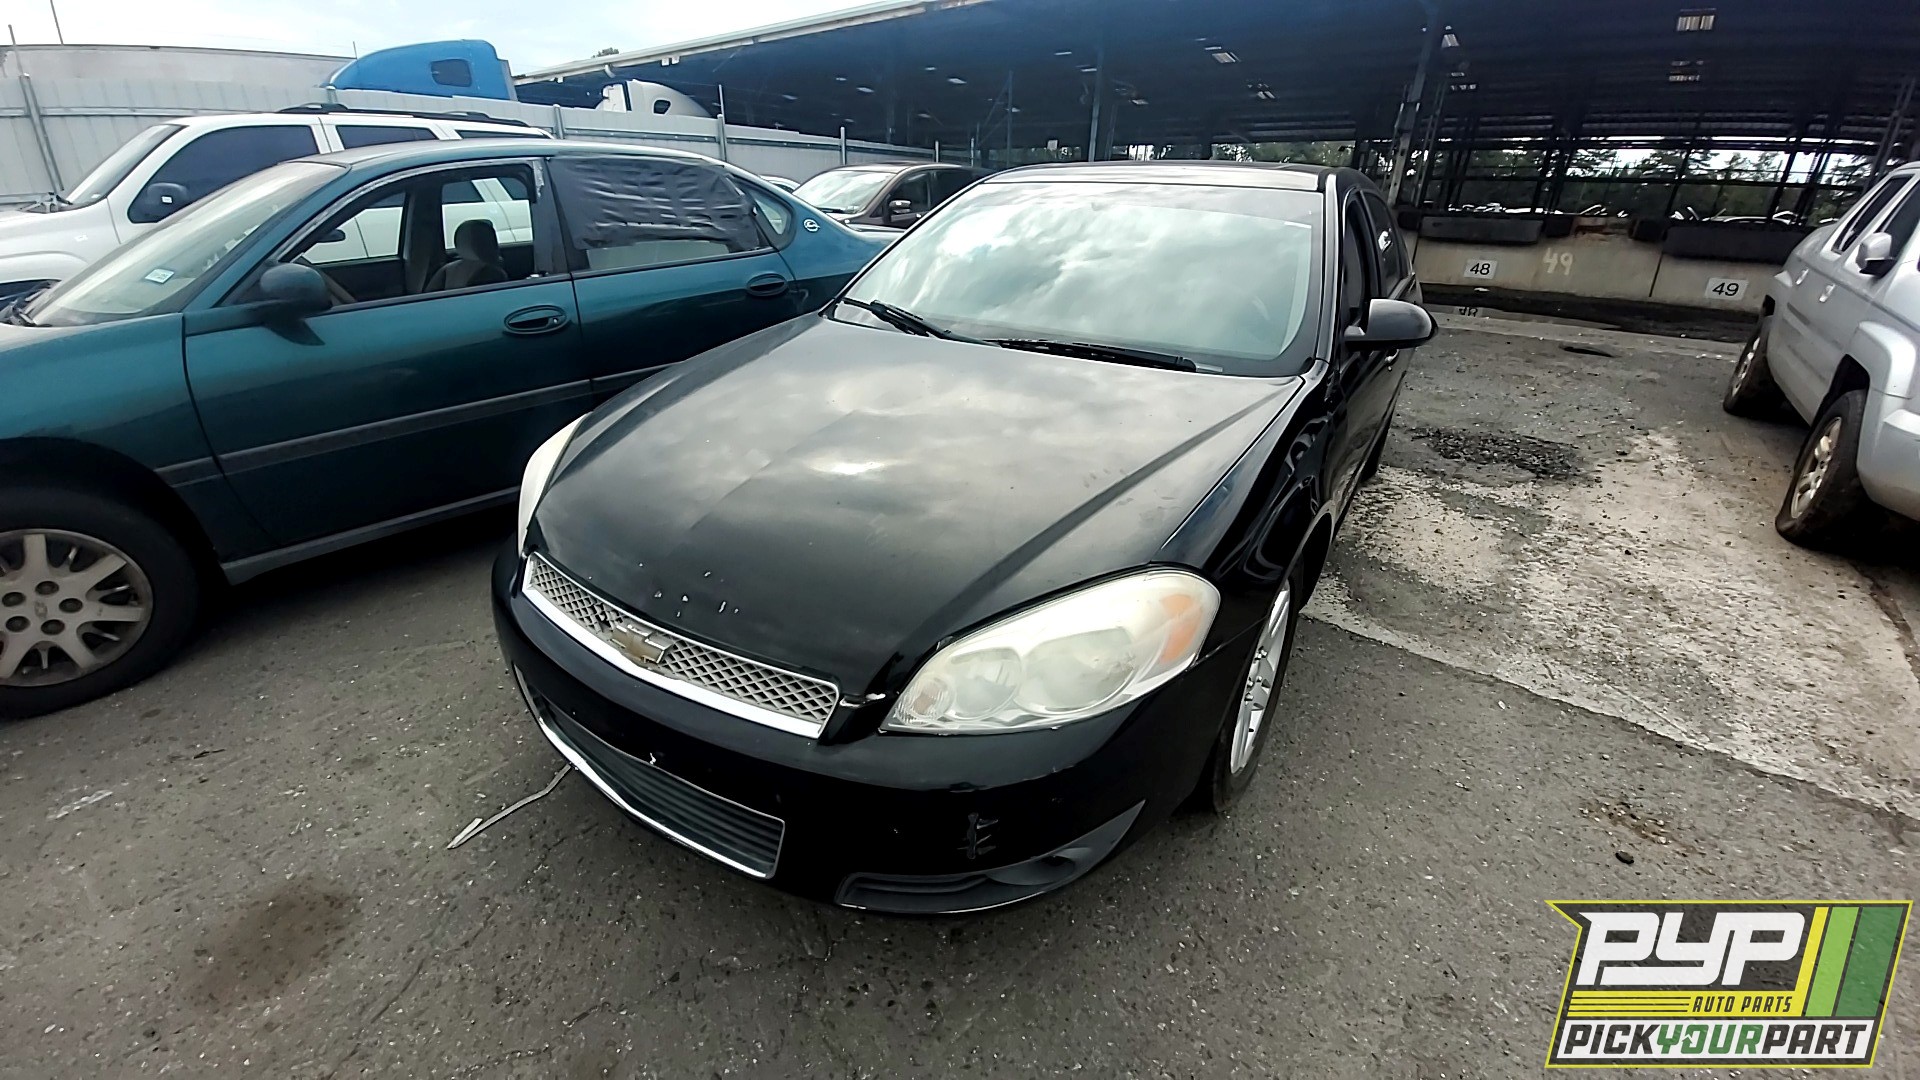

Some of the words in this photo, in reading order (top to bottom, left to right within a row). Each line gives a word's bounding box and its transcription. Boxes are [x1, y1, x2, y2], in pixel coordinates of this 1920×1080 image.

[1470, 263, 1491, 275] 48
[1543, 248, 1573, 276] 49
[1712, 282, 1739, 296] 49
